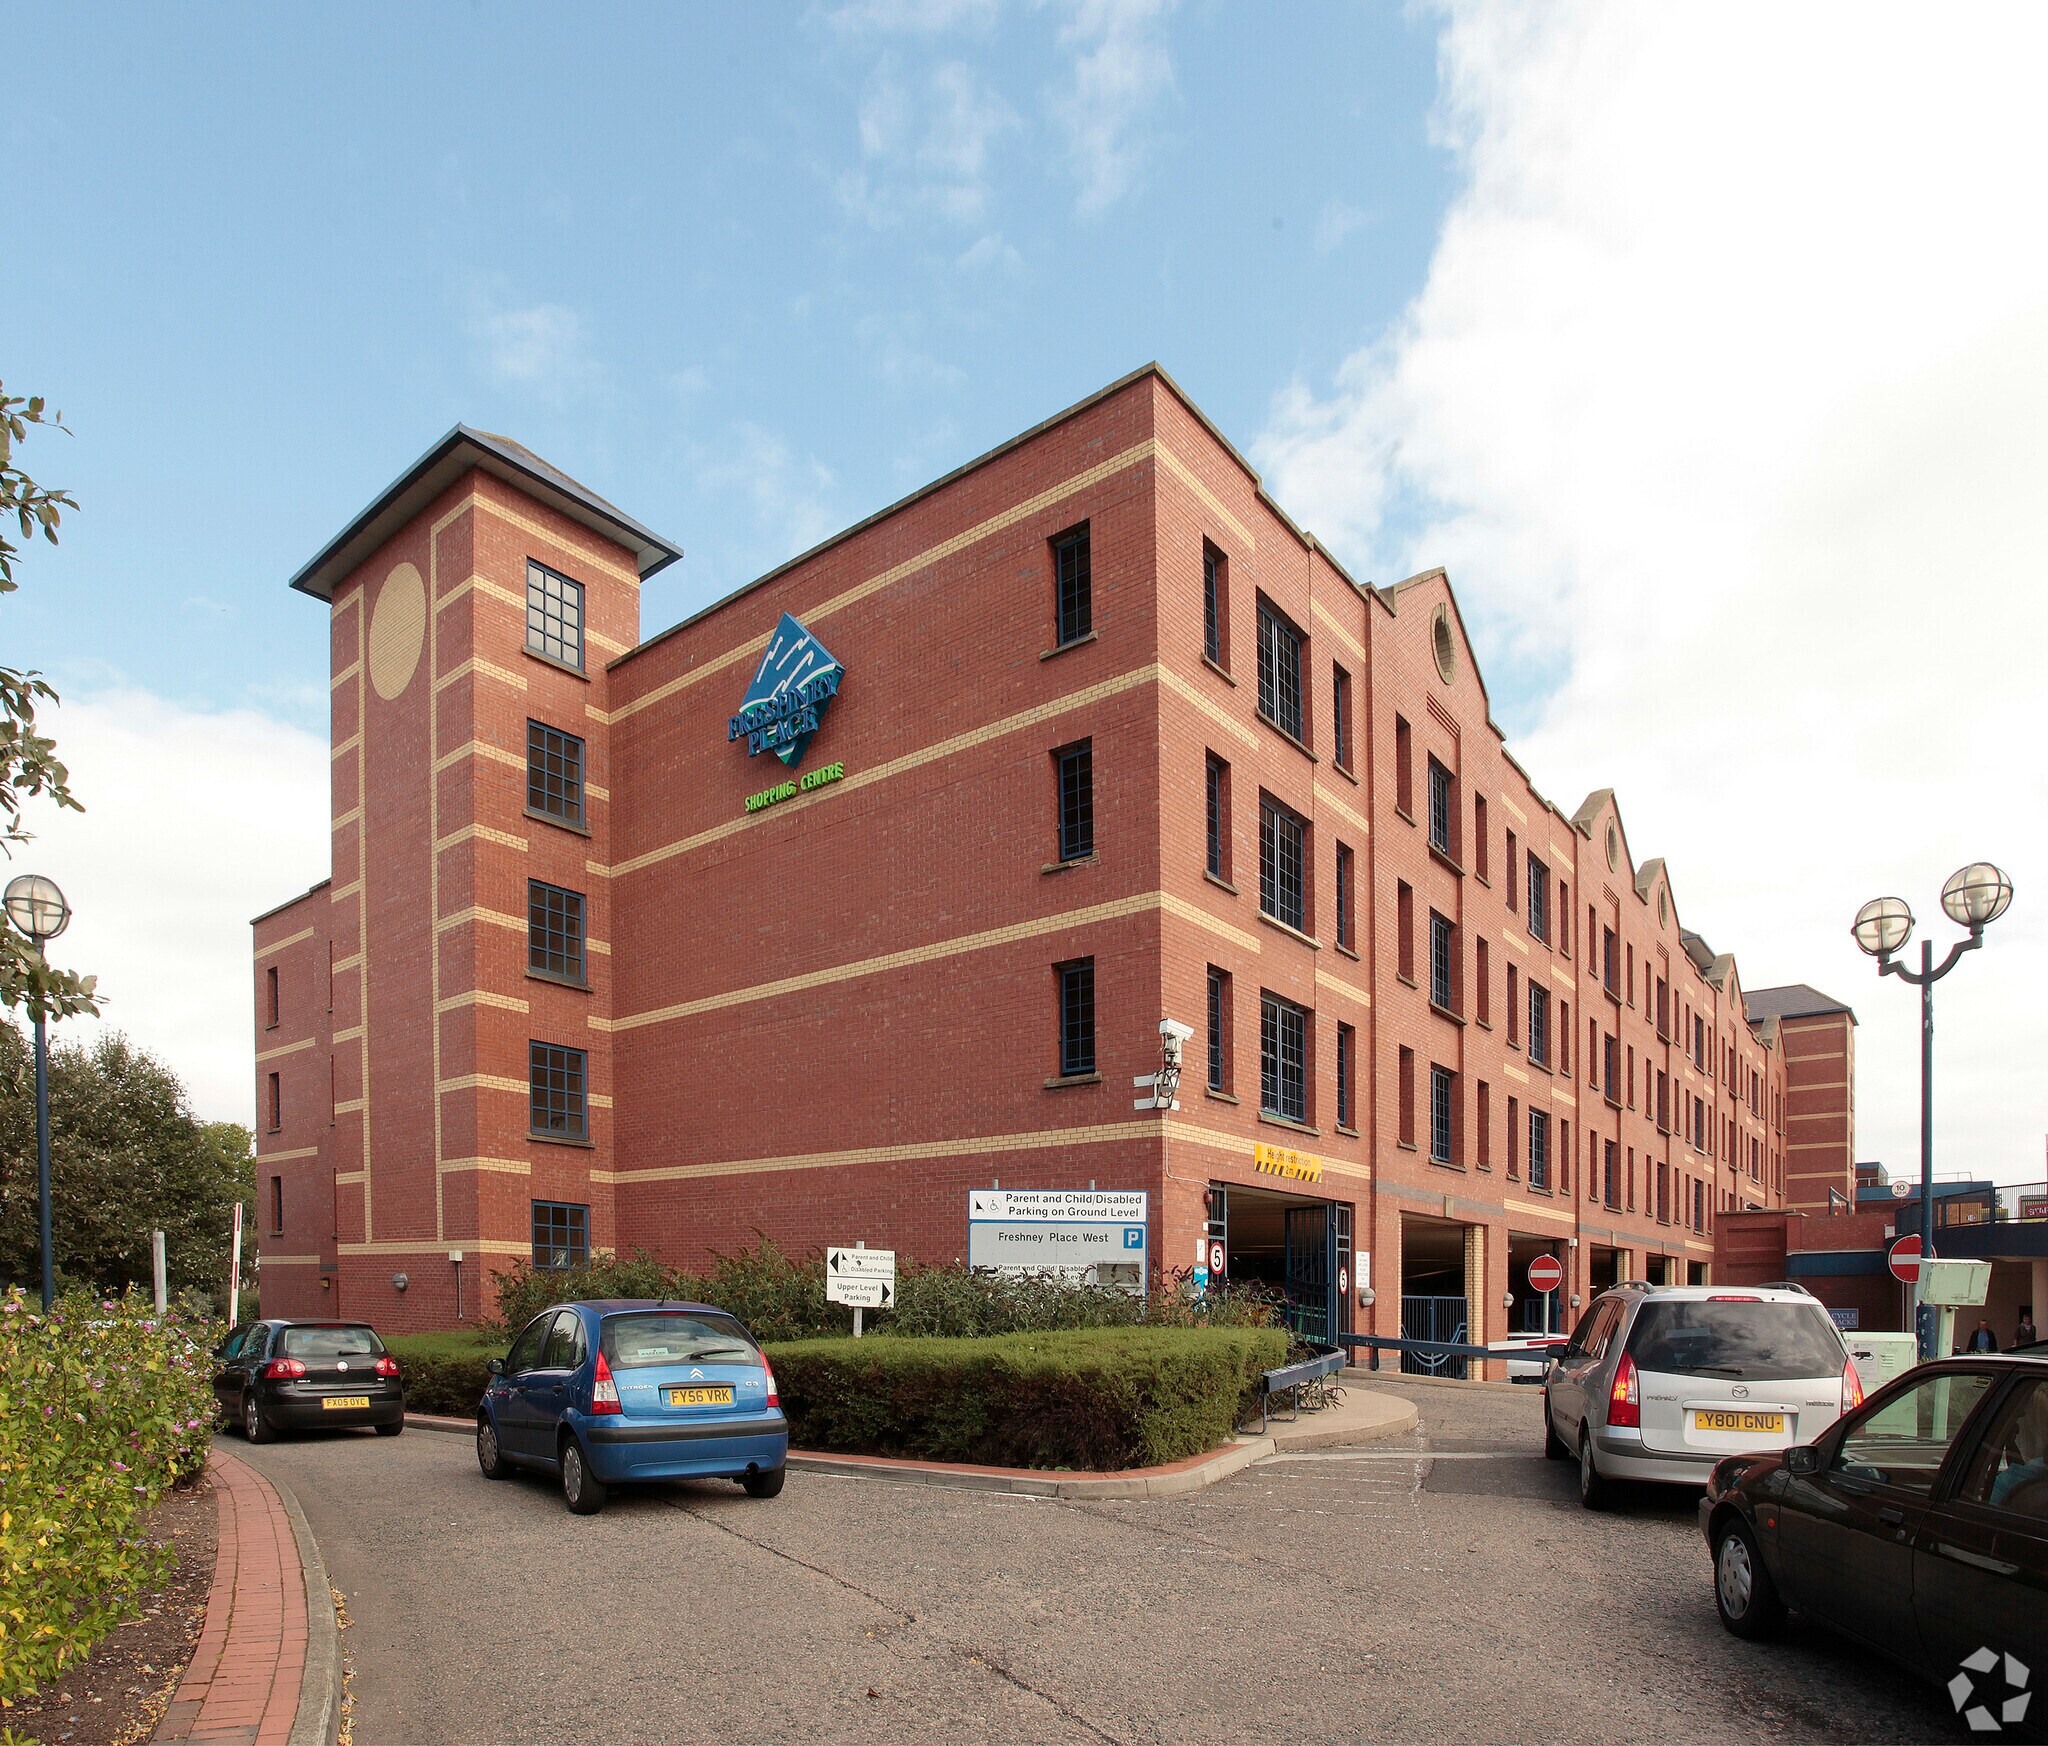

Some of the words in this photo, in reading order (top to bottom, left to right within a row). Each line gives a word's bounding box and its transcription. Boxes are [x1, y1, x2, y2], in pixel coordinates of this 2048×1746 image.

[727, 672, 838, 742] FRESHNEY
[748, 706, 819, 757] PLACE
[744, 780, 797, 812] SHOPPING
[800, 762, 844, 791] CENTRE
[1006, 1194, 1039, 1203] Parent
[1042, 1194, 1062, 1203] and
[1065, 1194, 1142, 1205] Child/Disabled
[1008, 1206, 1048, 1218] Parking
[1068, 1207, 1107, 1217] Ground
[1110, 1208, 1139, 1217] Level
[998, 1232, 1044, 1244] Freshney
[1049, 1233, 1078, 1242] Place
[1083, 1233, 1109, 1242] West
[1127, 1231, 1139, 1246] P
[1214, 1249, 1221, 1267] 5
[837, 1283, 858, 1291] Upper
[1341, 1272, 1346, 1288] 5
[844, 1293, 871, 1303] Parking
[671, 1391, 704, 1403] FY56
[706, 1389, 730, 1402] VRK
[1705, 1413, 1740, 1428] Y801
[1744, 1415, 1775, 1429] GNU
